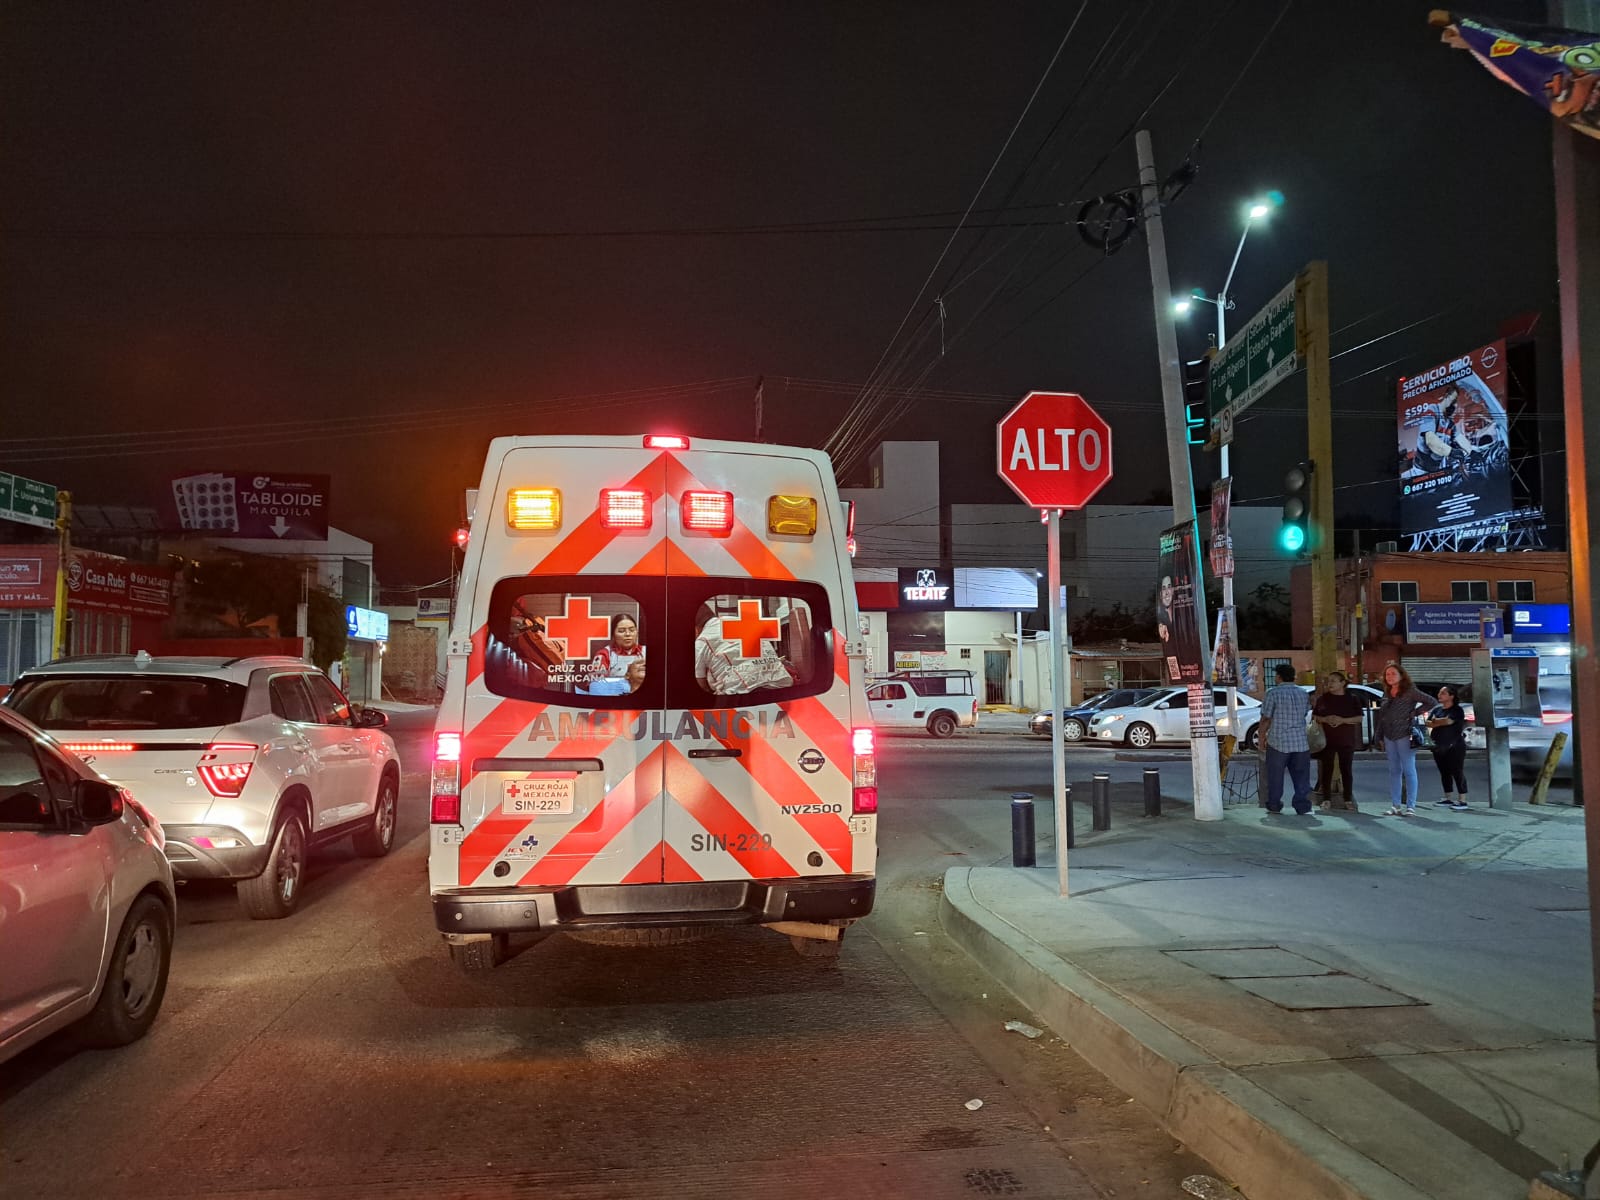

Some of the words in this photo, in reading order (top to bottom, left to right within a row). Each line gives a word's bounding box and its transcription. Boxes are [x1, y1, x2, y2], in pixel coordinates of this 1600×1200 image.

[1403, 366, 1446, 391] SERVICIO
[1403, 385, 1427, 400] PRECIO
[1428, 367, 1472, 391] AFICIONADO
[1405, 402, 1429, 418] $599
[1009, 428, 1101, 471] ALTO
[240, 491, 323, 506] TABLOIDE
[250, 506, 311, 516] MAQUILA
[86, 569, 106, 585] Casa
[903, 586, 950, 601] TECATE
[547, 664, 575, 673] CRUZ
[579, 664, 607, 673] ROJA
[547, 674, 606, 683] MEXICANA
[528, 710, 795, 742] AMBULANCIA
[515, 800, 561, 811] SIN-229
[781, 804, 842, 815] NV2500
[690, 833, 773, 852] SIN-229
